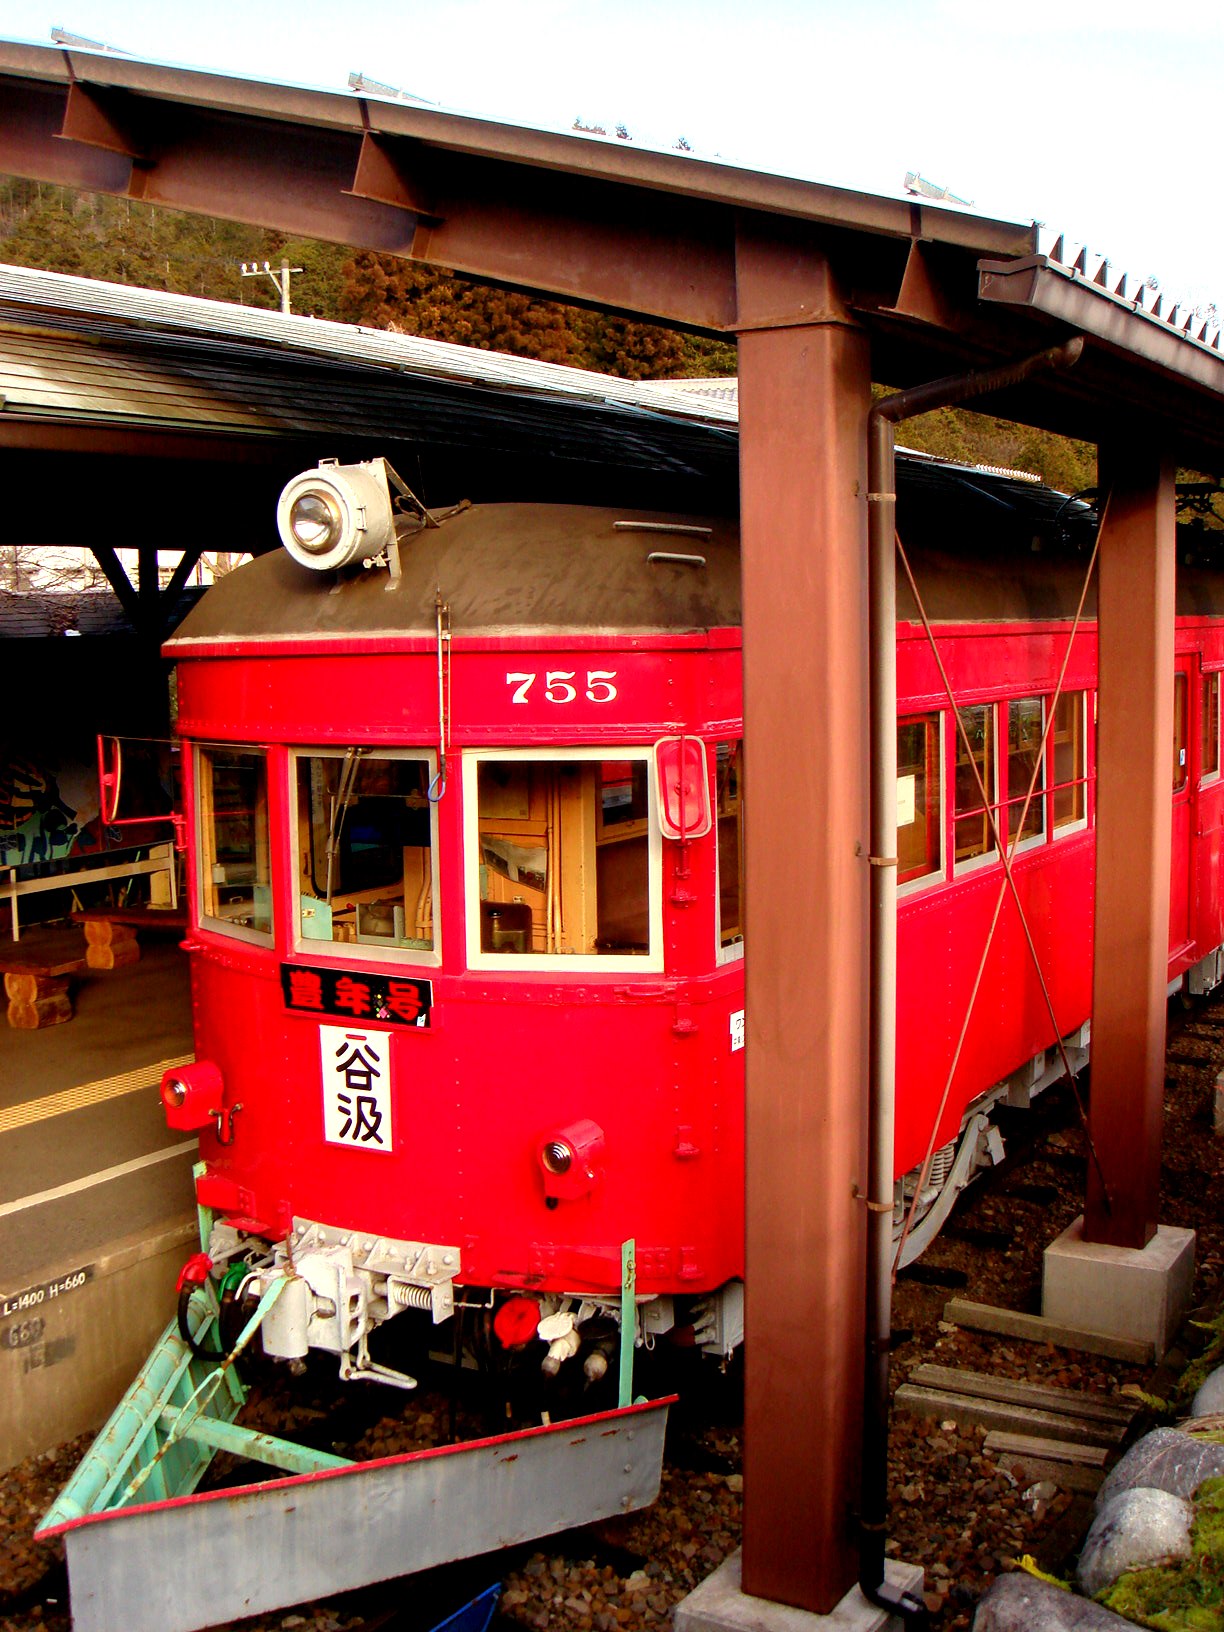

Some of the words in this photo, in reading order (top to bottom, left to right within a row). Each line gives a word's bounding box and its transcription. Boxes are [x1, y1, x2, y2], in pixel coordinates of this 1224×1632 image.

[506, 670, 618, 704] 755
[289, 970, 423, 1021] 豊年号
[335, 1041, 384, 1145] 谷汲
[3, 1290, 45, 1316] L=1400
[49, 1272, 86, 1299] H=660
